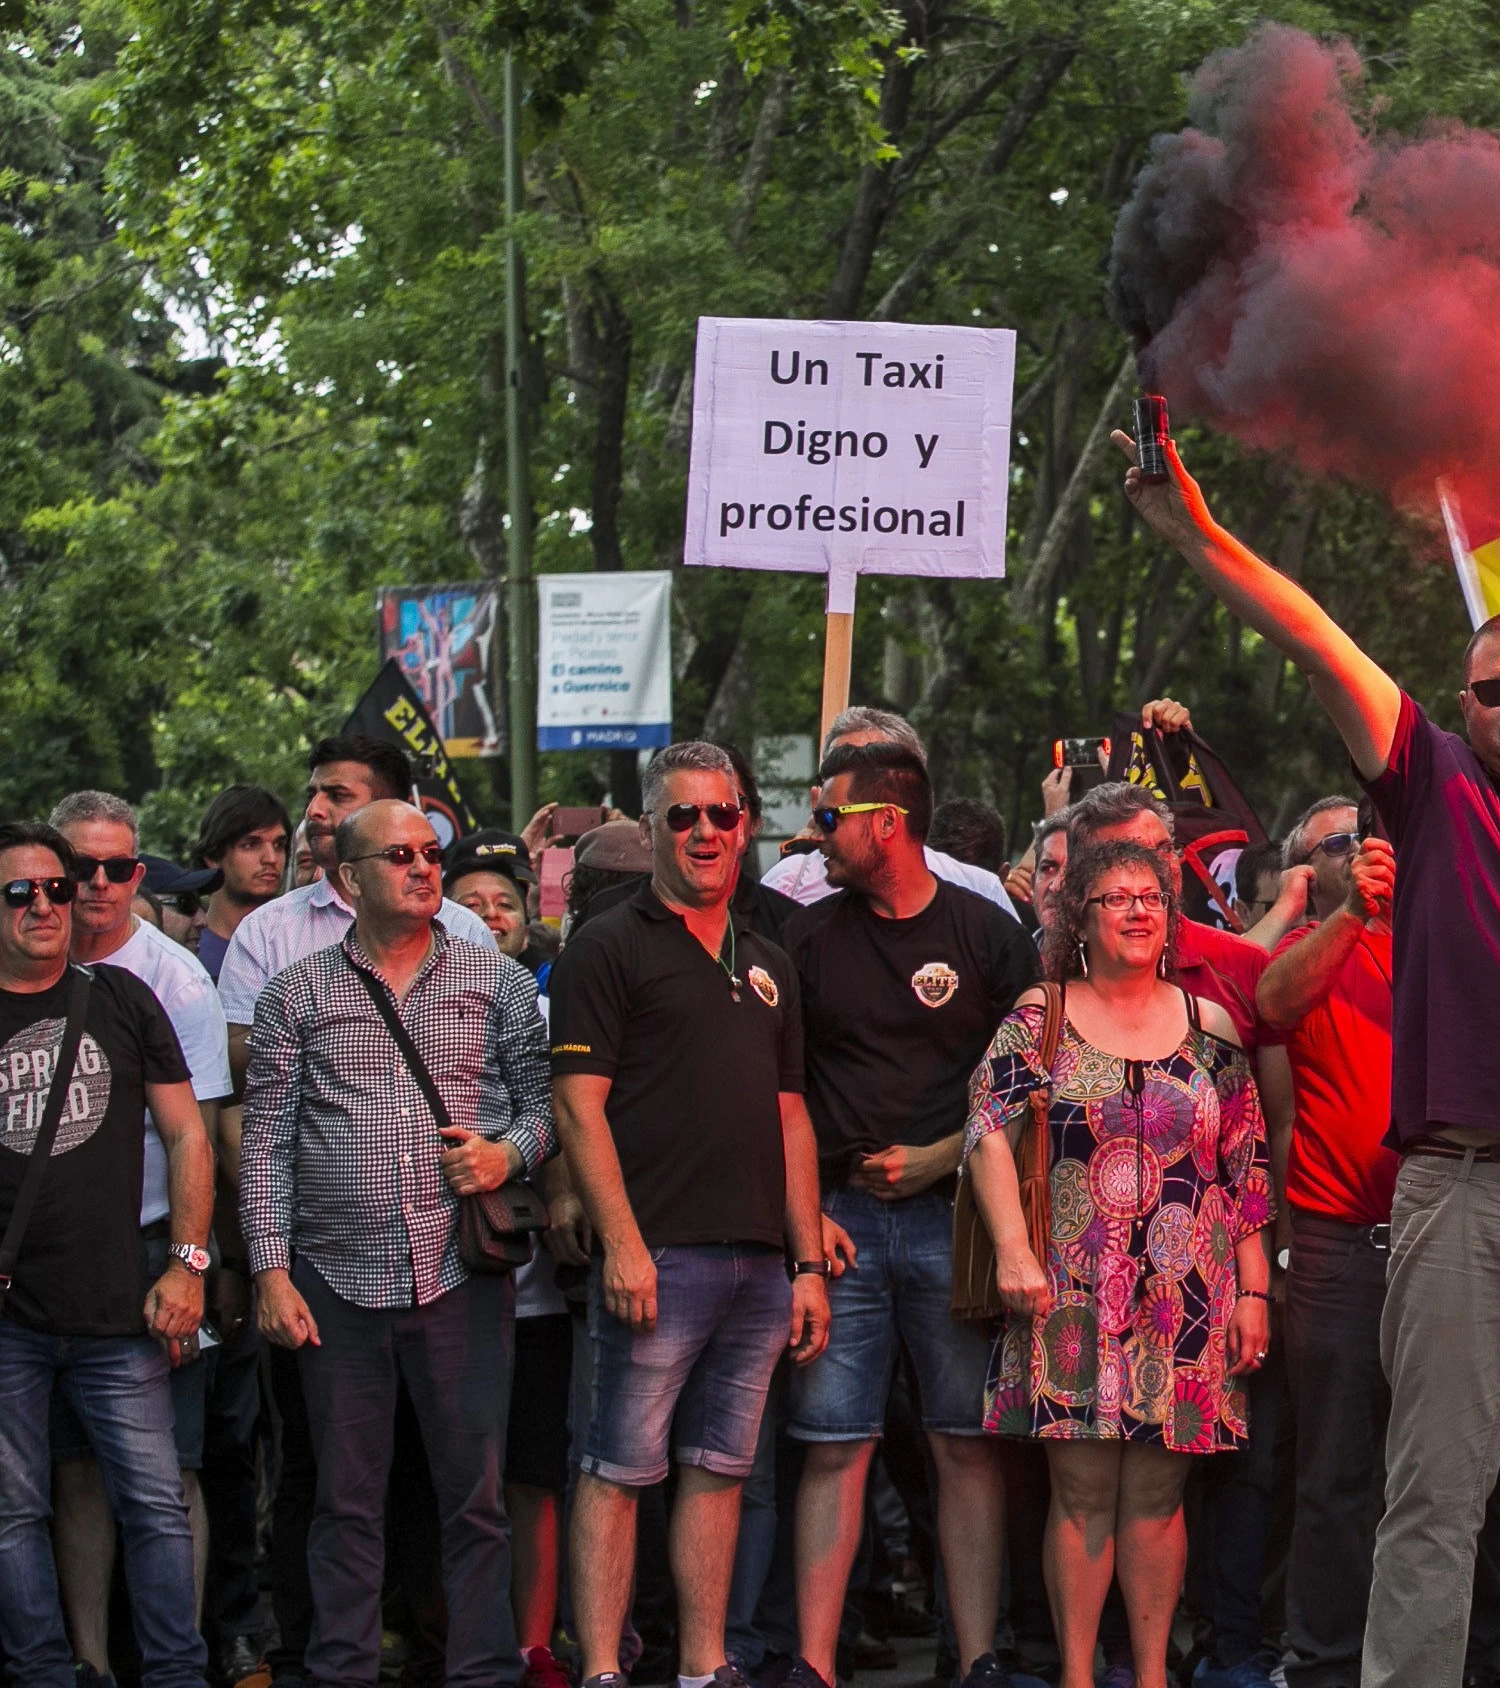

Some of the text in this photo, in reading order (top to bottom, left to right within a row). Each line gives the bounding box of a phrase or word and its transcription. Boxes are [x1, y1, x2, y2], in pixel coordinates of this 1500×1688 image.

[771, 350, 944, 389] Un Taxi
[763, 420, 939, 469] Digno y
[720, 494, 965, 537] profesional
[568, 664, 623, 676] camino
[586, 731, 636, 743] MADRID
